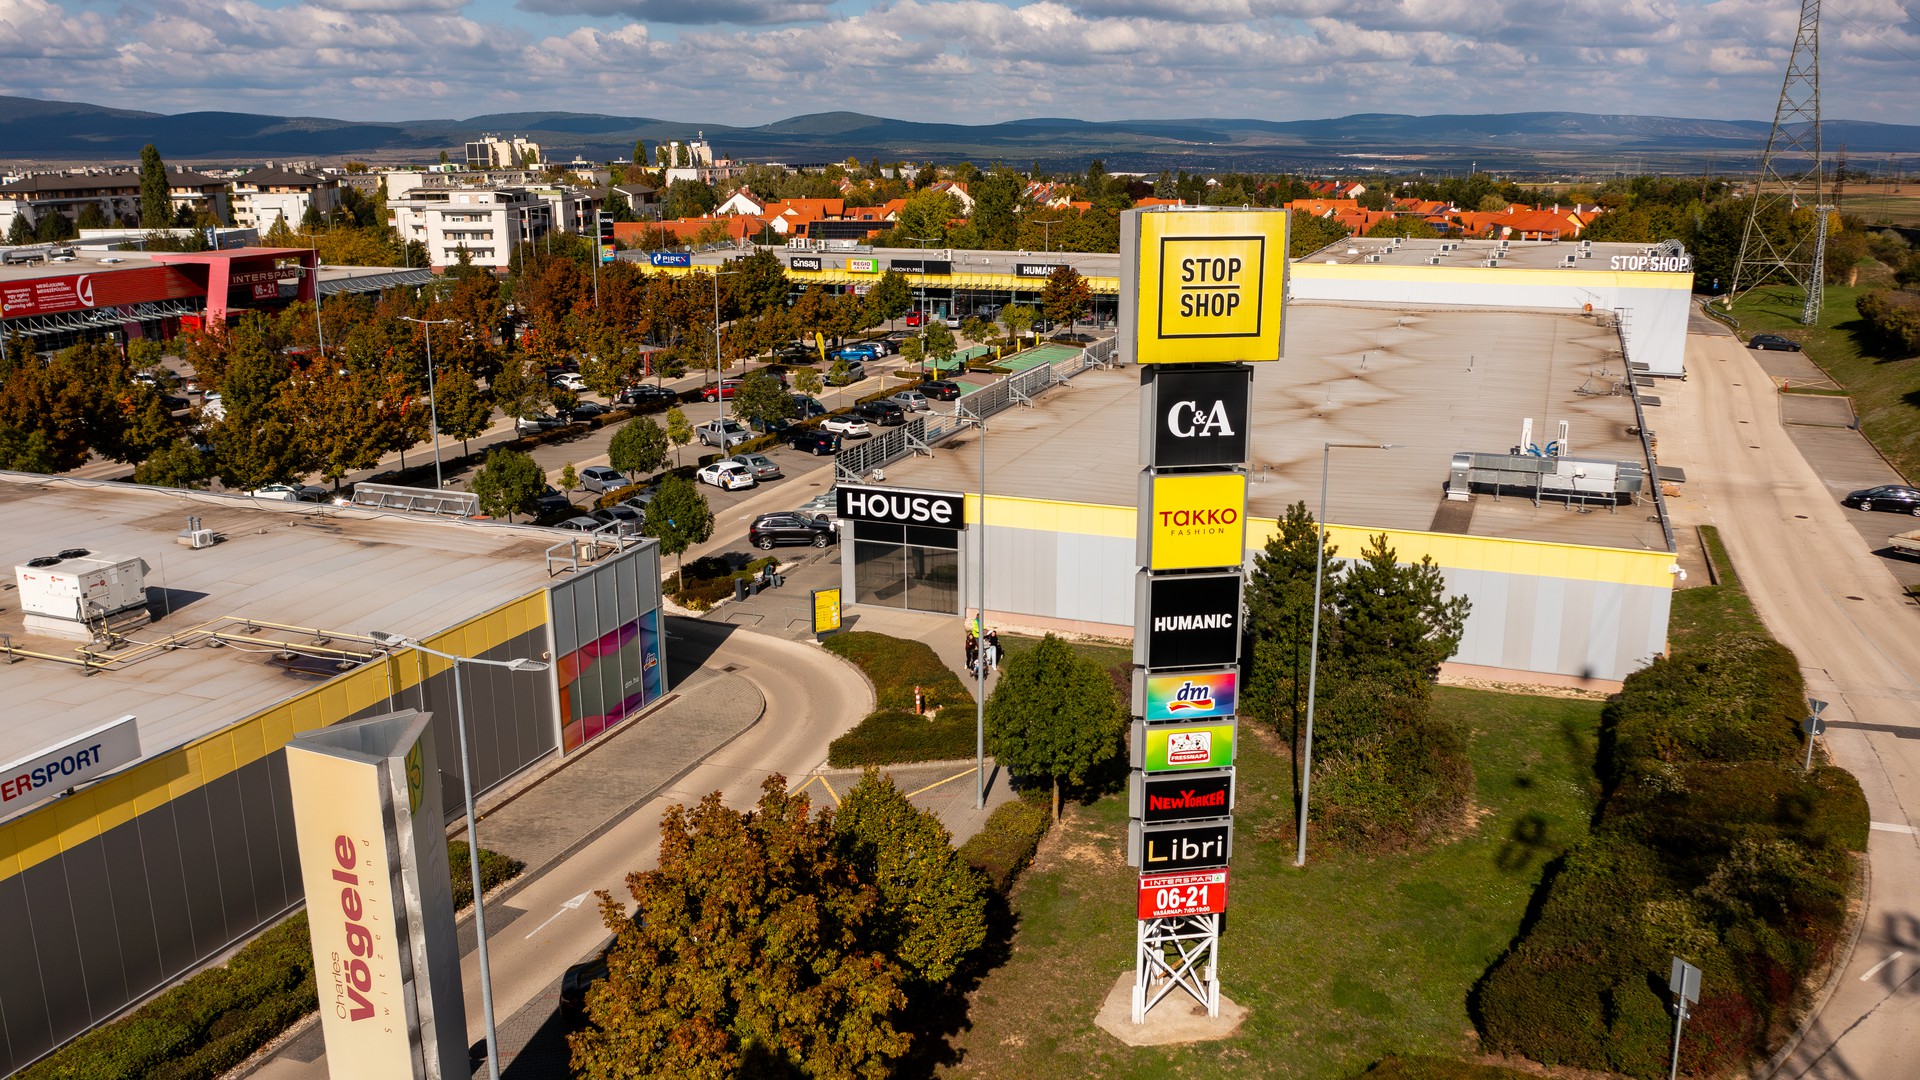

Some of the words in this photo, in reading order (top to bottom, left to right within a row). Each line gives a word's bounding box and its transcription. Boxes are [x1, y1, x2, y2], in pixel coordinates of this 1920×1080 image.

[793, 258, 819, 270] sinsay
[1182, 258, 1242, 282] STOP
[1610, 256, 1647, 270] STOP
[1650, 256, 1689, 272] SHOP
[233, 270, 295, 284] INTERSPAR
[1180, 293, 1240, 317] SHOP
[1168, 400, 1235, 438] C&A
[846, 492, 952, 524] HOUSE
[1159, 508, 1238, 526] TAKKO
[1170, 528, 1224, 536] FASHION
[1154, 614, 1232, 632] HUMANIC
[1176, 682, 1209, 701] dm
[0, 744, 102, 802] ERSPORT
[1148, 835, 1223, 862] Libri
[1150, 875, 1212, 886] INTERSPAR
[1156, 886, 1208, 910] 06-21
[332, 834, 376, 1022] Vögele
[332, 951, 347, 1020] Charles
